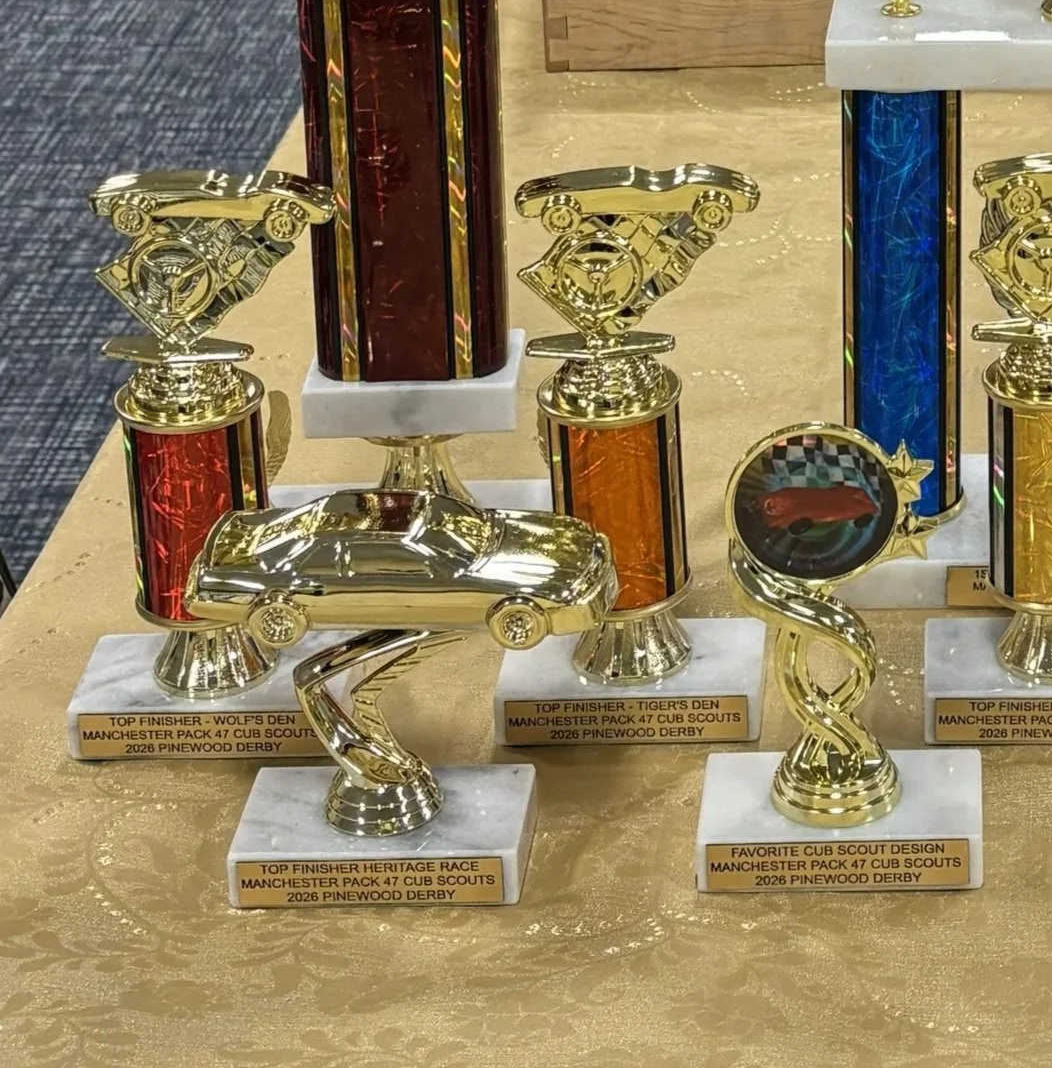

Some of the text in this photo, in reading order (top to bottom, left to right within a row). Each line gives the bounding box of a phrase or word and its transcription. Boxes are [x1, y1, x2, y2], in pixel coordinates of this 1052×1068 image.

[535, 703, 560, 714] TOP
[564, 701, 625, 713] FINISHER
[636, 700, 688, 711] TIGER'S
[691, 700, 719, 710] DEN
[969, 701, 995, 712] TOP
[108, 716, 137, 727] TOP
[140, 716, 202, 726] FINISHER
[213, 715, 265, 725] WOLF'S
[267, 714, 296, 725] DEN
[508, 713, 741, 728] MANCHESTER PACK 47 CUB SCOUTS
[938, 715, 1027, 726] MANCHESTER
[82, 729, 173, 741] MANCHESTER
[177, 729, 213, 740] PACK
[214, 729, 229, 739] 47
[233, 729, 261, 738] CUB
[550, 726, 705, 740] 2026 PINEWOOD DERBY
[979, 728, 1007, 739] 2026
[125, 742, 283, 754] 2026 PINEWOOD DERBY
[731, 843, 945, 858] FAVORITE CUB SCOUT DESIGN
[259, 861, 479, 875] TOP FINISHER HERITAGE RACE
[710, 857, 962, 873] MANCHESTER PACK 47 CUB SCOUTS
[241, 875, 495, 889] MANCHESTER PACK 47 CUB SCOUTS
[755, 872, 922, 886] 2026 PINEWOOD DERBY
[287, 890, 456, 902] 2026 PINEWOOD DERBY
